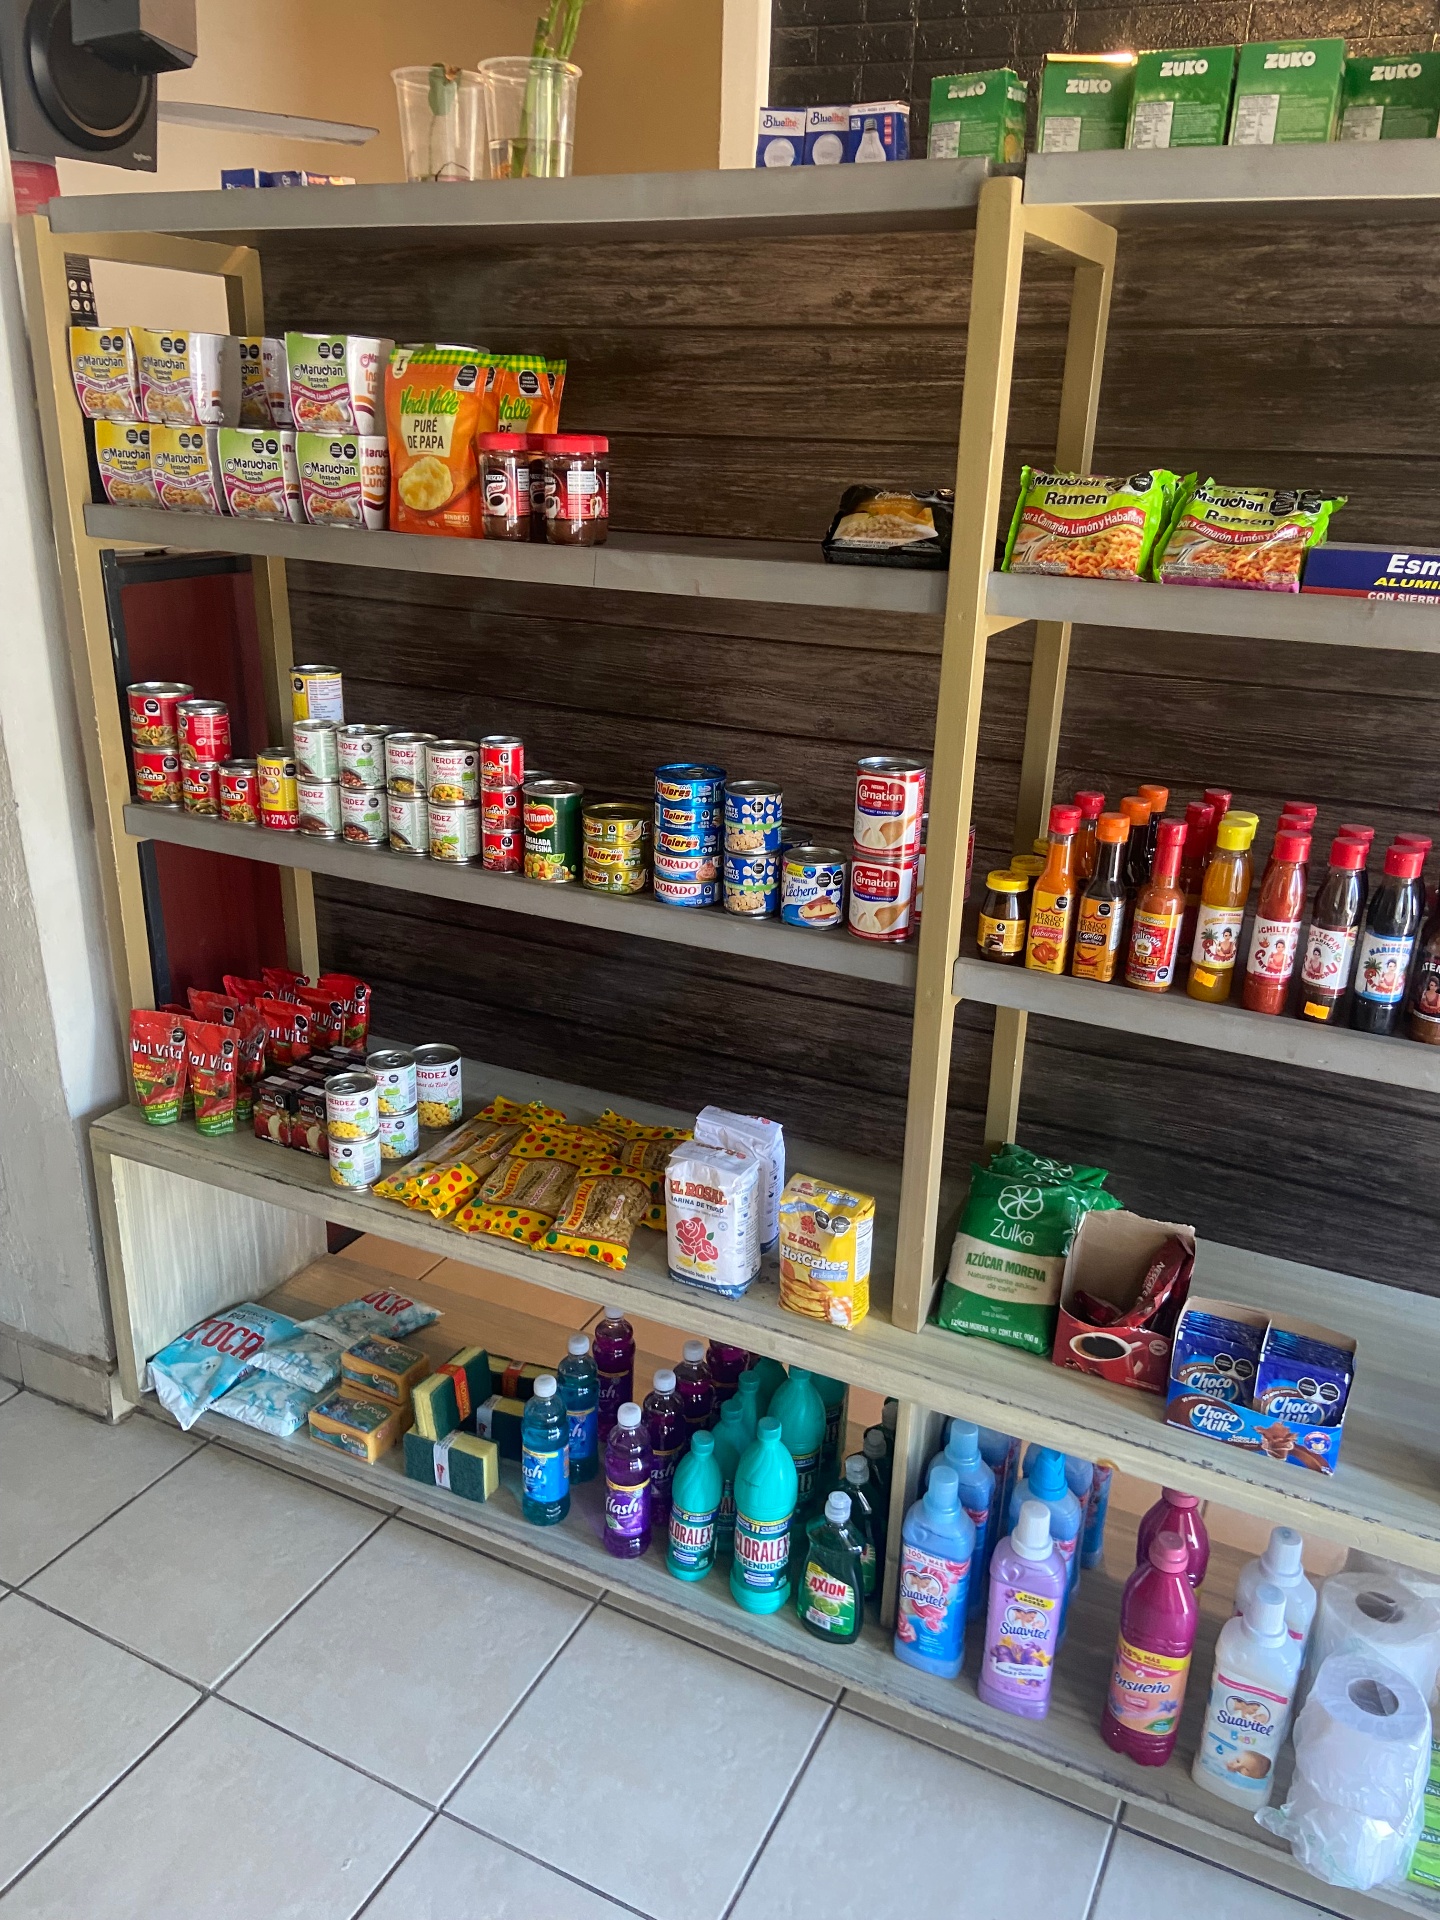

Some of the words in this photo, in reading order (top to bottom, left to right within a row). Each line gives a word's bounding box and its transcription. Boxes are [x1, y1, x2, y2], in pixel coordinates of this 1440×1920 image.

[1160, 59, 1209, 77] ZUKO
[1264, 51, 1317, 69] ZUKO
[1370, 63, 1422, 81] ZUKO
[1065, 79, 1112, 93] ZUKO
[84, 355, 124, 368] Maruchan
[147, 357, 185, 371] Maruchan
[300, 364, 343, 377] Maruchan
[414, 416, 437, 432] PURÉ
[408, 435, 419, 449] DE
[420, 435, 444, 450] PAPA
[110, 447, 150, 460] Maruchan
[163, 453, 204, 465] Maruchan
[234, 458, 279, 471] Maruchan
[311, 461, 357, 475] Maruchan
[1044, 490, 1108, 505] Ramen
[1194, 489, 1266, 513] Maruchan
[1205, 509, 1276, 527] Ramen
[1071, 521, 1098, 535] Limón
[1233, 532, 1262, 543] Limón
[1367, 591, 1395, 601] CON
[431, 755, 463, 765] HERDEZ
[657, 780, 692, 798] Dolores
[858, 783, 905, 802] Carnation
[270, 813, 289, 826] 27%
[530, 813, 554, 823] Monte
[664, 808, 695, 822] Dolores
[661, 833, 699, 850] Dolores
[588, 846, 623, 861] Dolores
[656, 857, 699, 870] DORADO
[853, 869, 899, 889] Carnation
[655, 883, 697, 896] DORADO
[785, 885, 818, 897] Lechera
[284, 1030, 309, 1044] Vita
[132, 1038, 152, 1054] Val
[155, 1043, 183, 1061] Vita
[209, 1054, 232, 1072] Vita
[685, 1182, 728, 1206] ROSAL
[696, 1200, 706, 1209] DE
[989, 1218, 1035, 1247] Zulka
[787, 1231, 798, 1244] EL
[797, 1236, 822, 1252] ROSAL
[780, 1243, 850, 1272] HotCakes
[965, 1251, 1004, 1272] AZÚCAR
[1004, 1260, 1047, 1284] MORENA
[986, 1283, 997, 1291] de
[183, 1318, 266, 1361] FOCA
[1186, 1371, 1233, 1389] Choco
[1193, 1403, 1240, 1422] Choco
[1270, 1396, 1318, 1415] Choco
[1197, 1418, 1236, 1434] Milk
[809, 1576, 846, 1597] AXION
[901, 1584, 945, 1608] Suavitel
[1000, 1622, 1051, 1641] Suavitel
[1216, 1708, 1275, 1737] Suavitel
